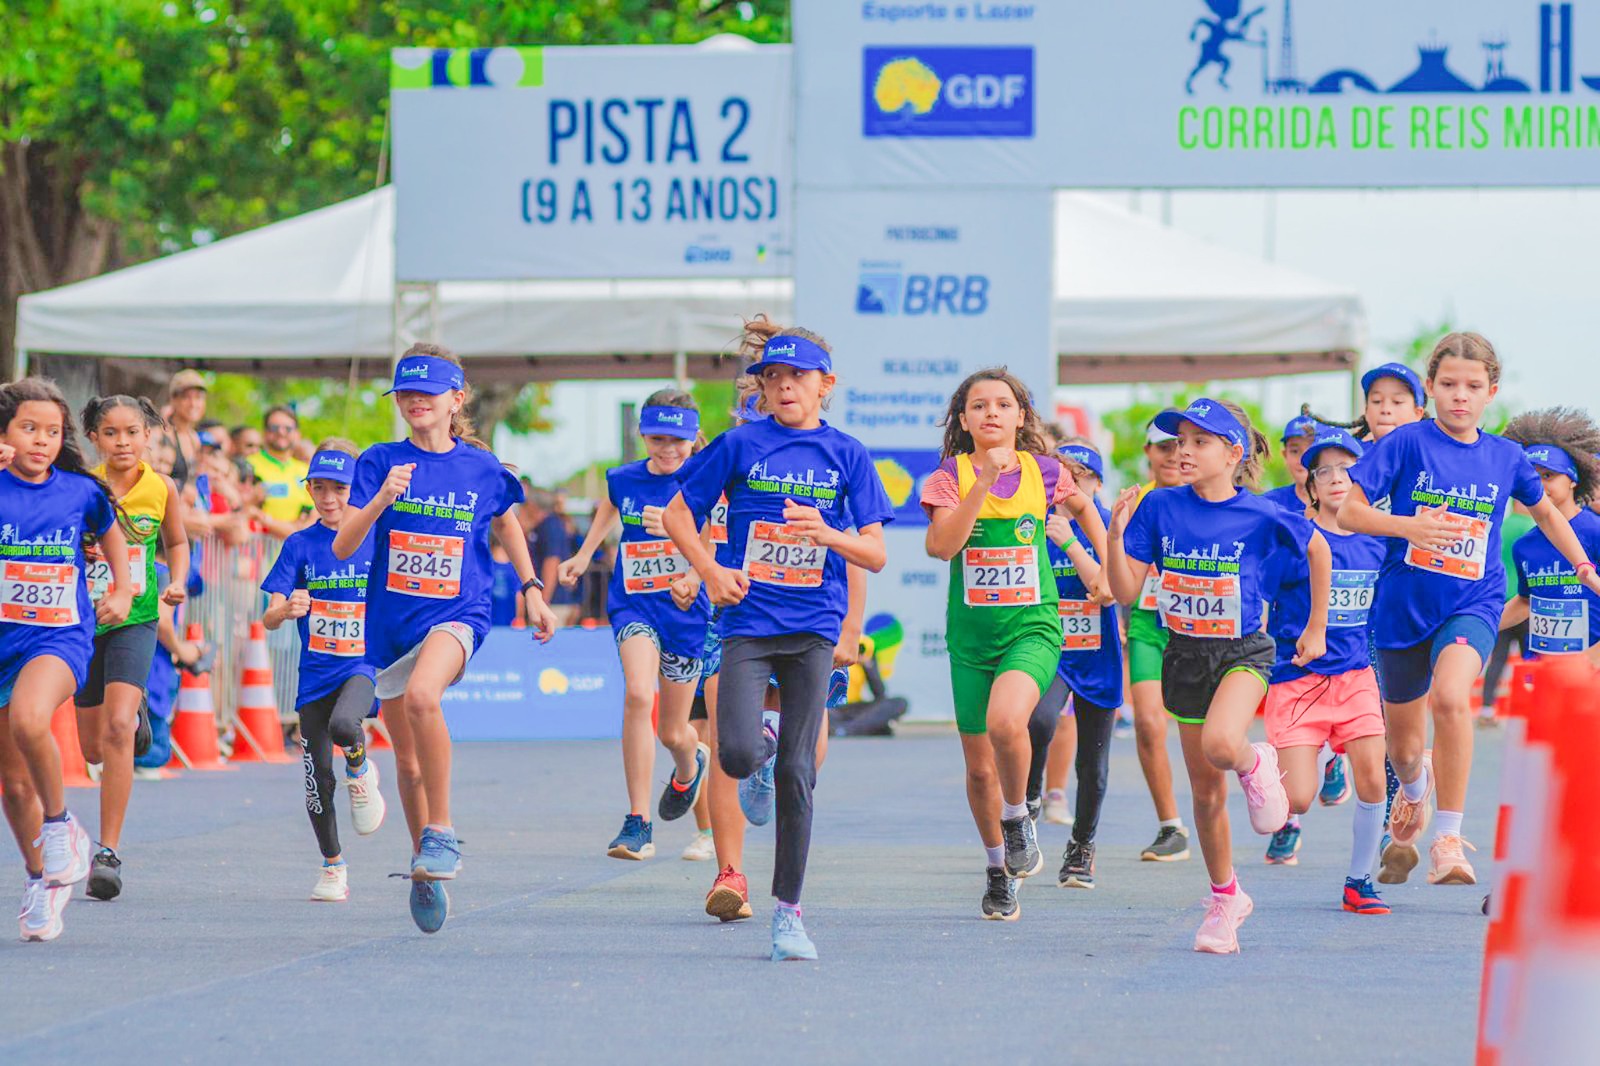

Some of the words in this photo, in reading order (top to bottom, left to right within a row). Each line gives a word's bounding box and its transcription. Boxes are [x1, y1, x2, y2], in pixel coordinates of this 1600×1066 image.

[863, 1, 947, 22] Esporte
[955, 6, 967, 19] e
[975, 2, 1034, 19] Lazer
[945, 75, 1025, 108] GDF
[549, 98, 699, 165] PISTA
[719, 97, 751, 163] 2
[1178, 105, 1338, 150] CORRIDA
[1351, 105, 1395, 150] DE
[1409, 105, 1490, 150] REIS
[521, 177, 557, 223] (9
[571, 178, 593, 222] A
[612, 177, 652, 222] 13
[665, 176, 778, 222] ANOS)
[902, 273, 991, 316] BRB
[781, 482, 793, 494] DE
[793, 484, 812, 497] REIS
[816, 499, 834, 510] 2024
[1411, 490, 1444, 505] CORRIDA
[1446, 495, 1457, 508] DE
[1457, 498, 1475, 511] REIS
[423, 505, 434, 516] DE
[435, 507, 453, 519] REIS
[395, 552, 453, 578] 2845
[759, 542, 818, 567] 2034
[631, 557, 677, 577] 2413
[1187, 559, 1198, 571] DE
[1198, 559, 1217, 572] REIS
[974, 566, 1027, 587] 2212
[10, 583, 65, 606] 2837
[1328, 589, 1369, 607] 3316
[1563, 585, 1583, 595] 2024
[1168, 593, 1225, 617] 2104
[315, 618, 361, 638] 2113
[1534, 615, 1573, 637] 3377
